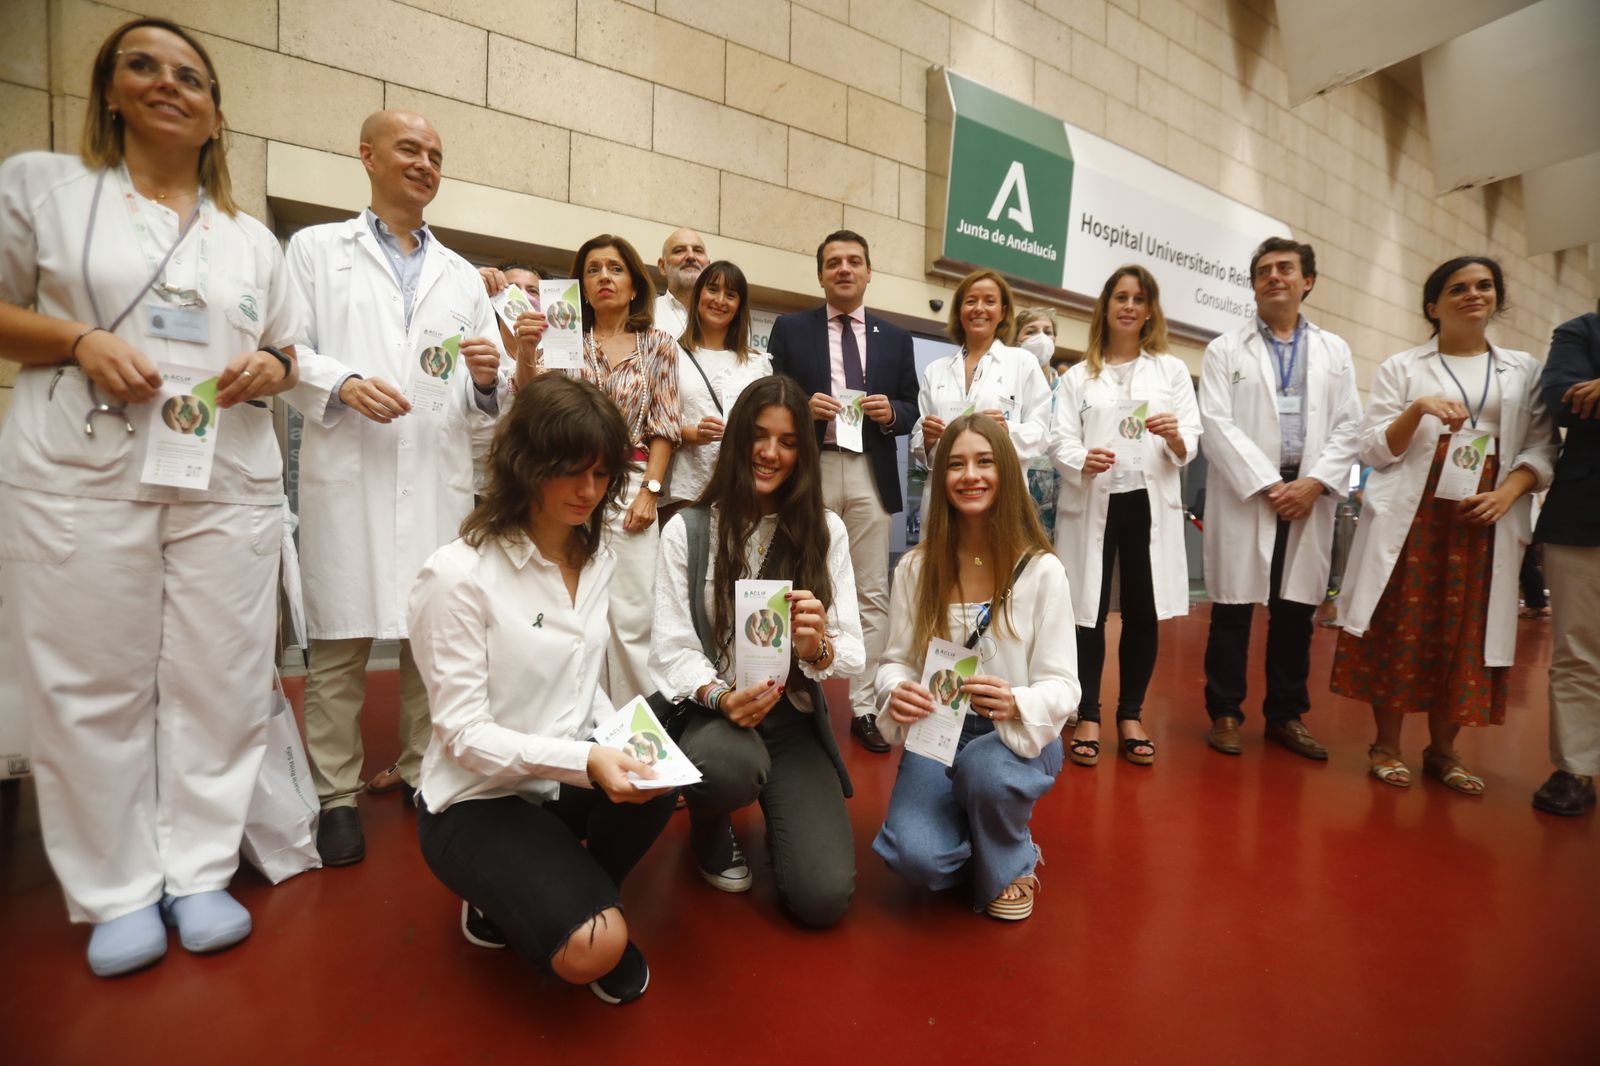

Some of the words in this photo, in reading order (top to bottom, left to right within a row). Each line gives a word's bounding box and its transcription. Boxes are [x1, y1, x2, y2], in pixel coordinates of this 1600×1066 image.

[956, 219, 990, 241] Junta
[991, 228, 1006, 245] de
[1006, 234, 1057, 261] Andalucía
[1081, 212, 1144, 252] Hospital
[1146, 236, 1227, 281] Universitario
[1195, 288, 1243, 316] Consultas
